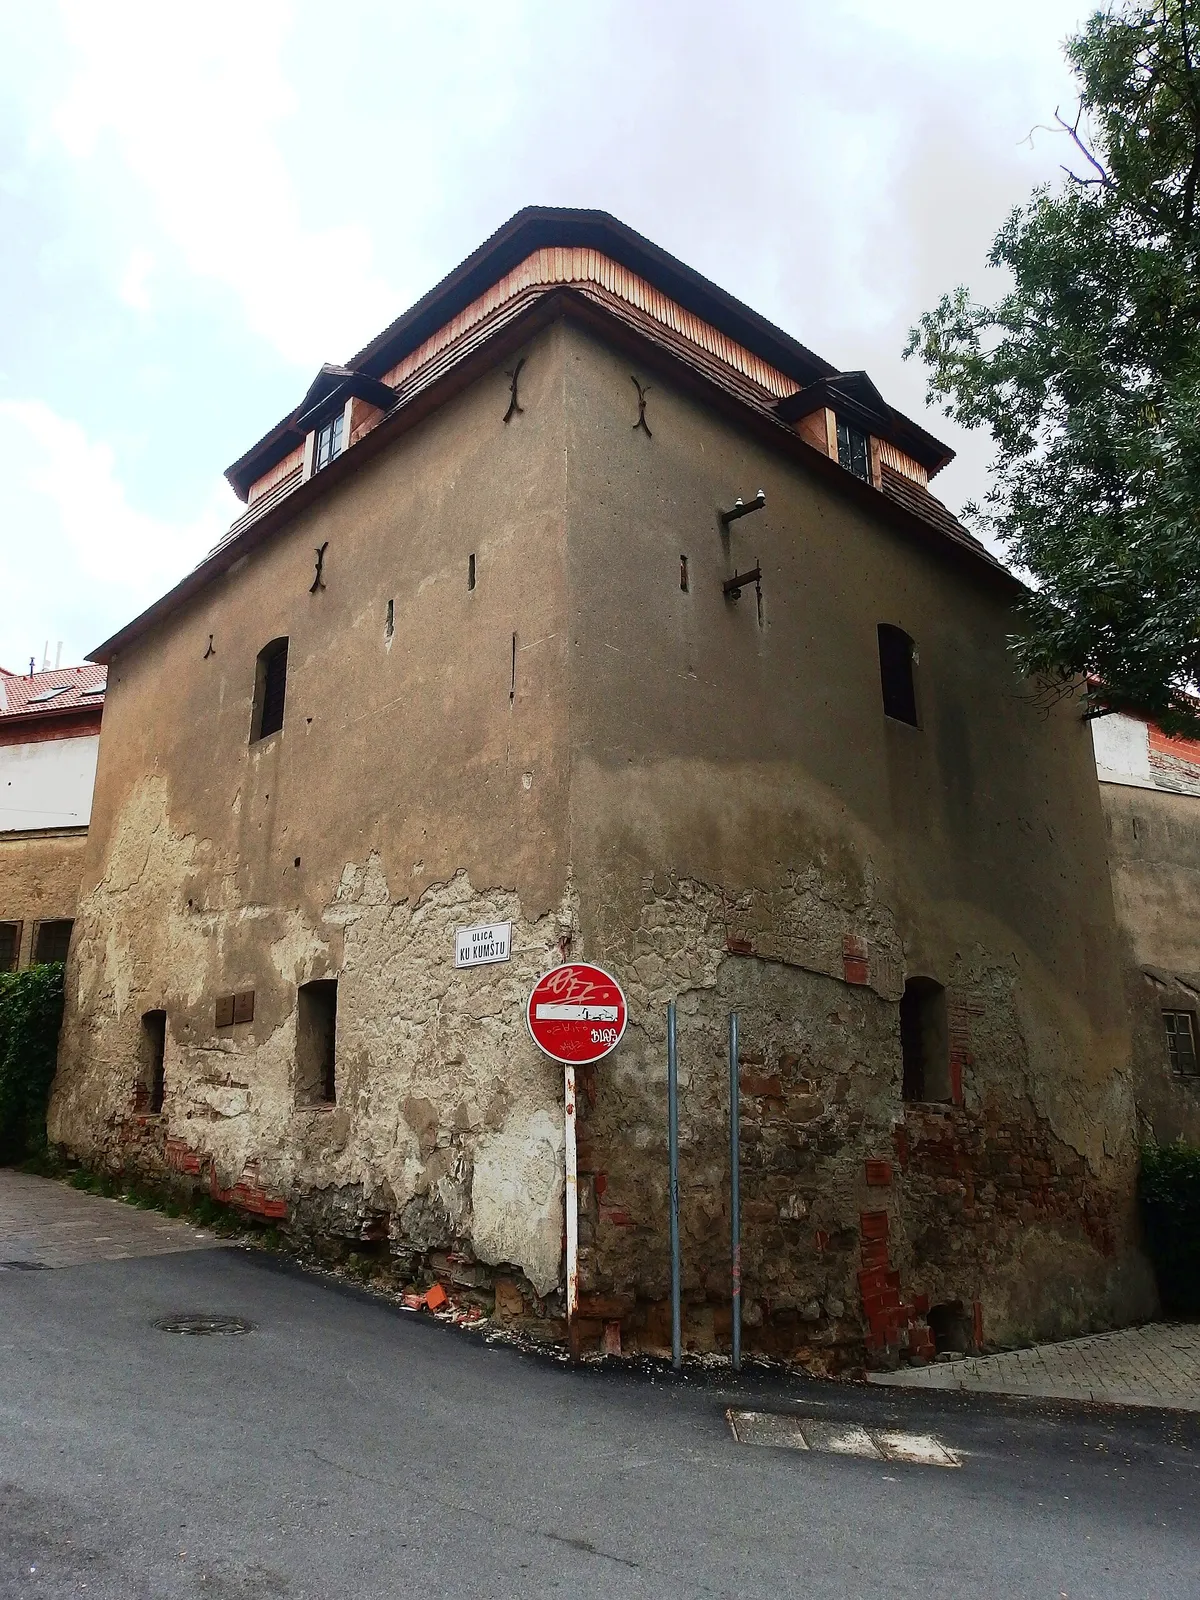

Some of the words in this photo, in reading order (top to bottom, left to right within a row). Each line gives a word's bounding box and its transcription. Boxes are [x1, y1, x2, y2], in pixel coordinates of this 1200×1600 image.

[472, 931, 493, 942] ULICA
[460, 947, 470, 961] KU
[473, 940, 505, 959] KUMŠTU
